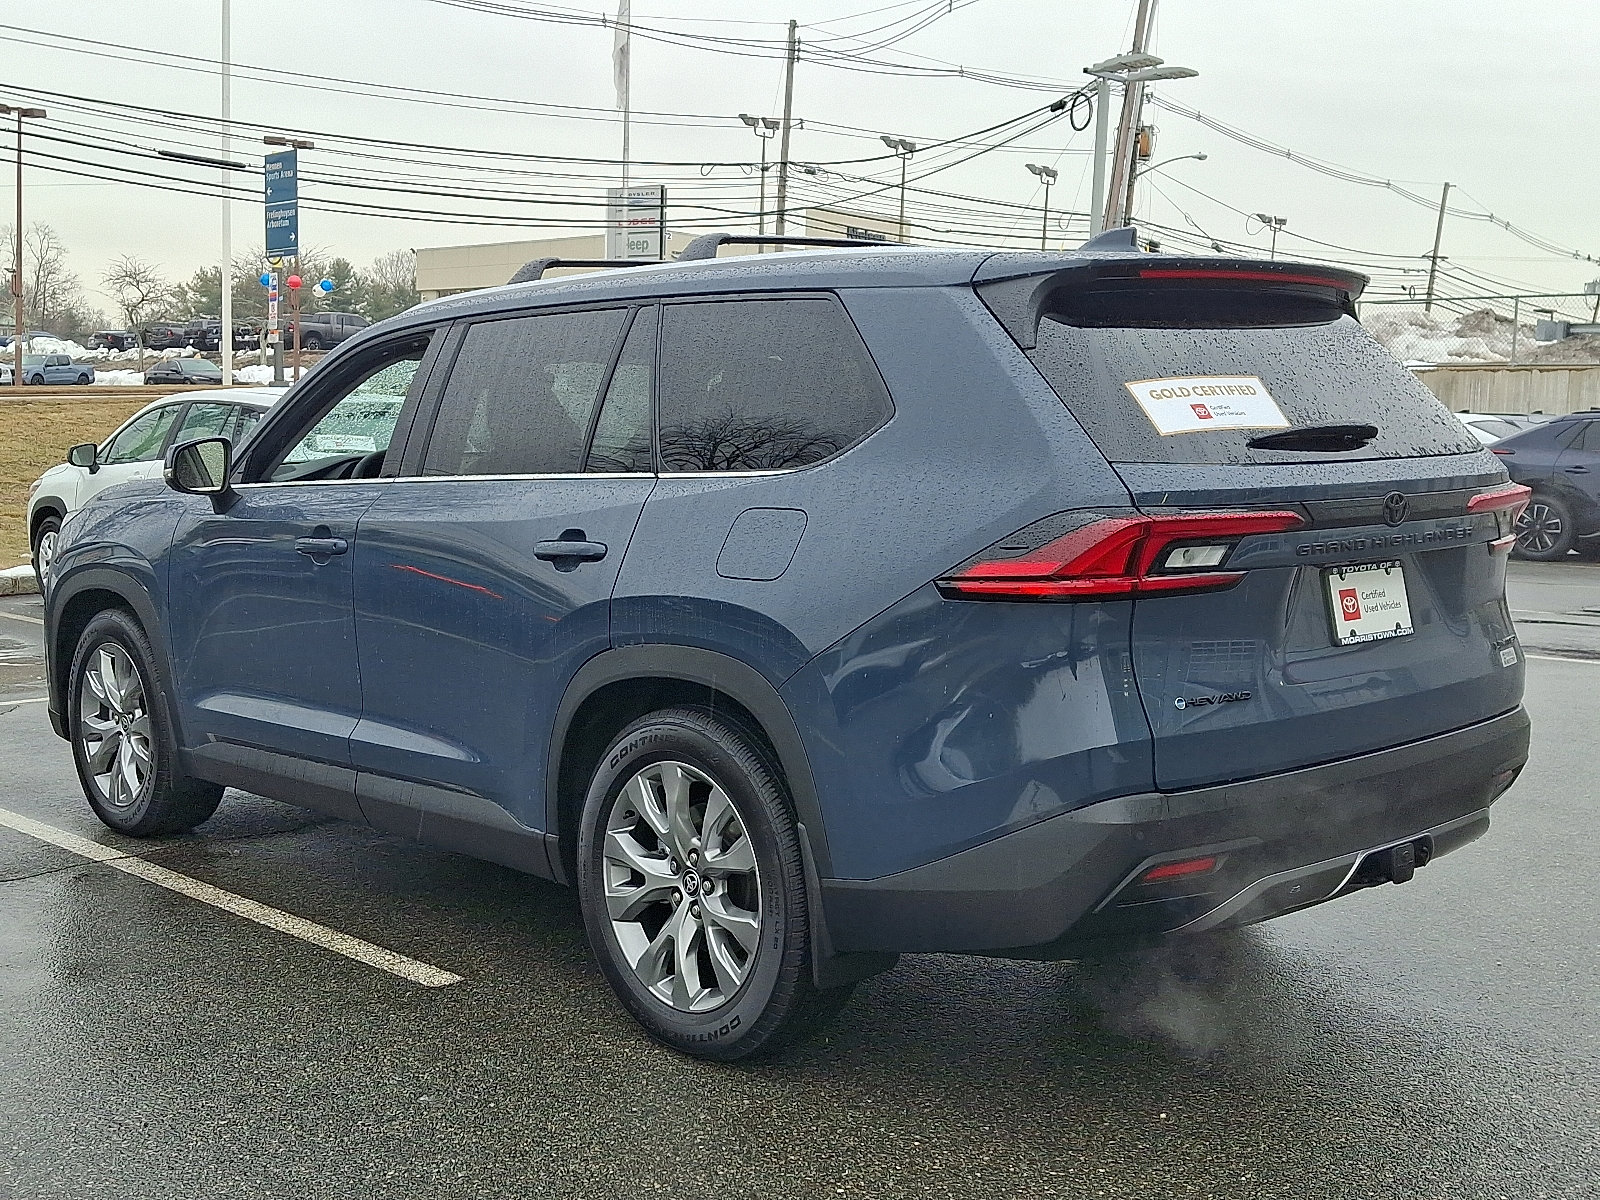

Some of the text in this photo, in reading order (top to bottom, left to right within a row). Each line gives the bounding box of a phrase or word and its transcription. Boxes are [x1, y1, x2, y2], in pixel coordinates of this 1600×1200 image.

[266, 169, 294, 182] Sports Arena
[266, 208, 296, 220] Frelinghuysen
[266, 218, 290, 229] Arboretum
[1148, 384, 1258, 400] GOLD CERTIFIED
[1296, 526, 1474, 557] GRAND HIGHLANDER
[1341, 561, 1392, 574] TOYOTA OF
[1361, 588, 1386, 600] Certified
[1363, 600, 1402, 613] Used Vehicles
[1341, 626, 1415, 646] MORRISTOWN.COM
